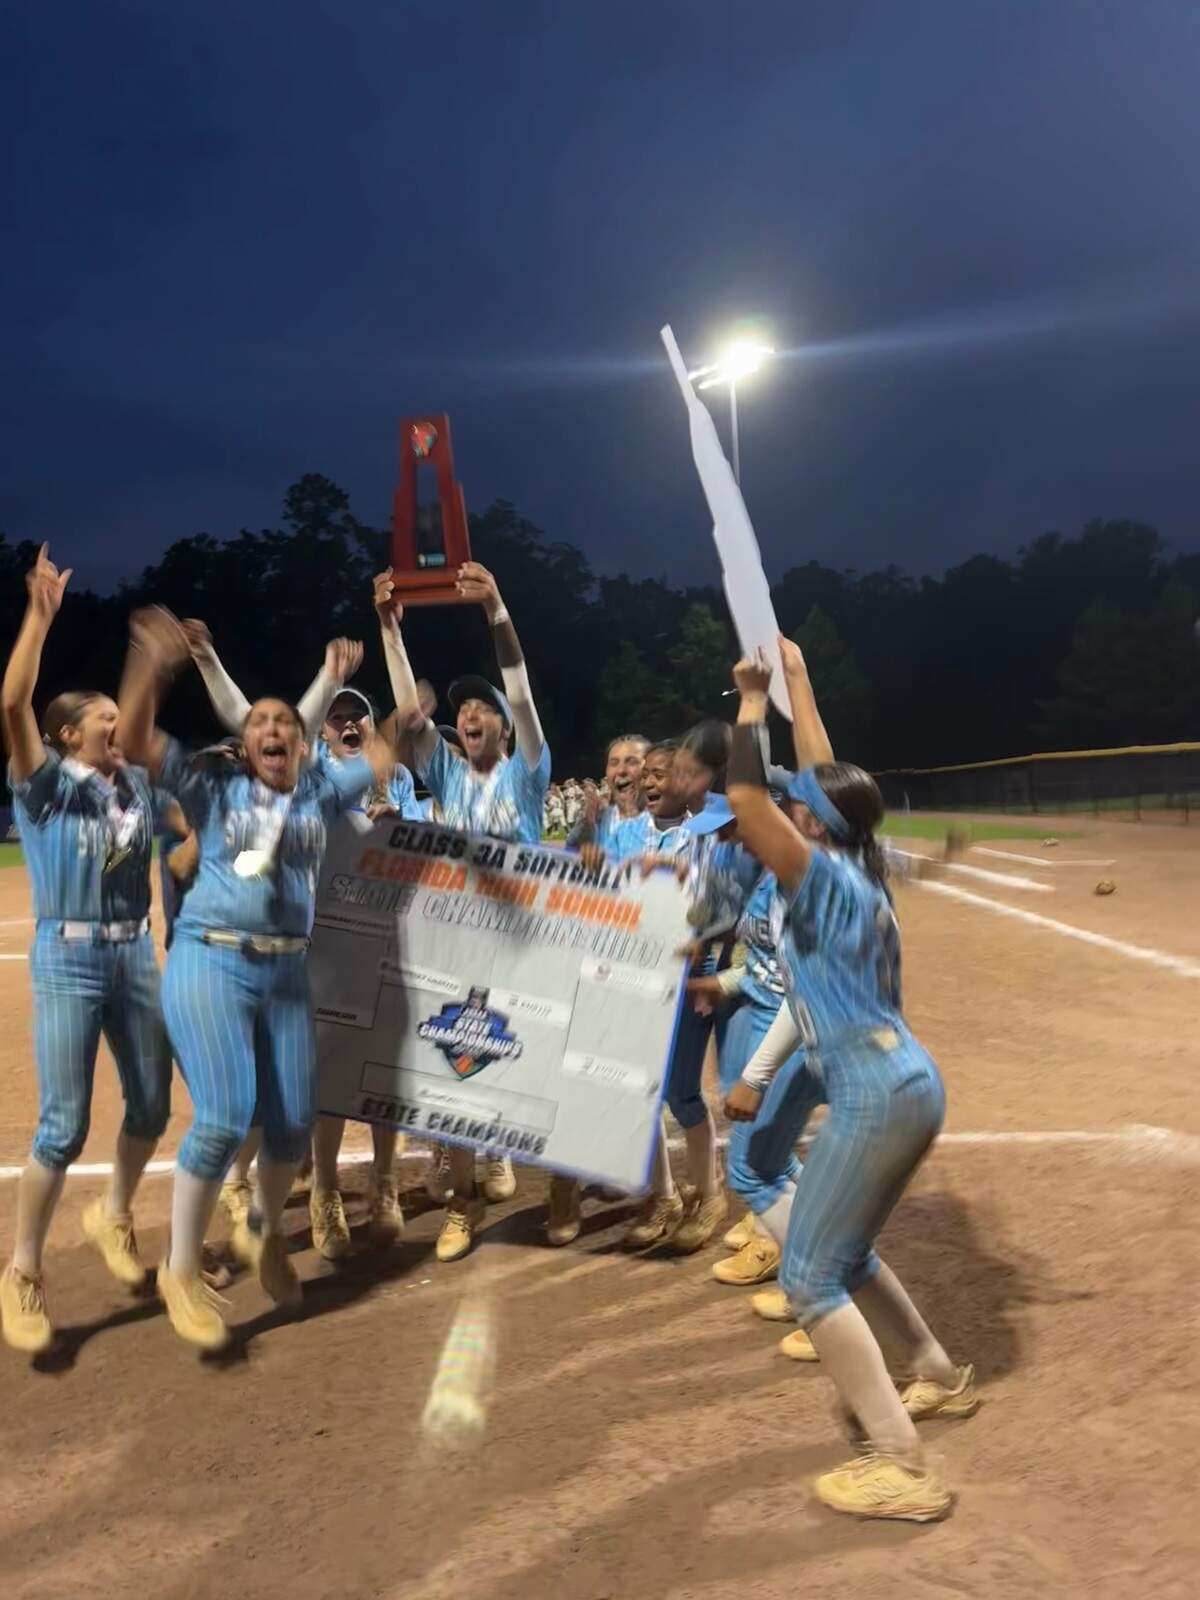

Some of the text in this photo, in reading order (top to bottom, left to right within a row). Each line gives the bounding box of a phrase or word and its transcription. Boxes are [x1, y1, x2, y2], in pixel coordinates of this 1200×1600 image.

[388, 825, 468, 859] CLASS
[472, 842, 508, 869] 3A
[360, 848, 468, 892] FLORIDA
[418, 1022, 523, 1060] CHAMPIONSHIPS
[361, 1097, 548, 1155] STATE CHAMPIONS
